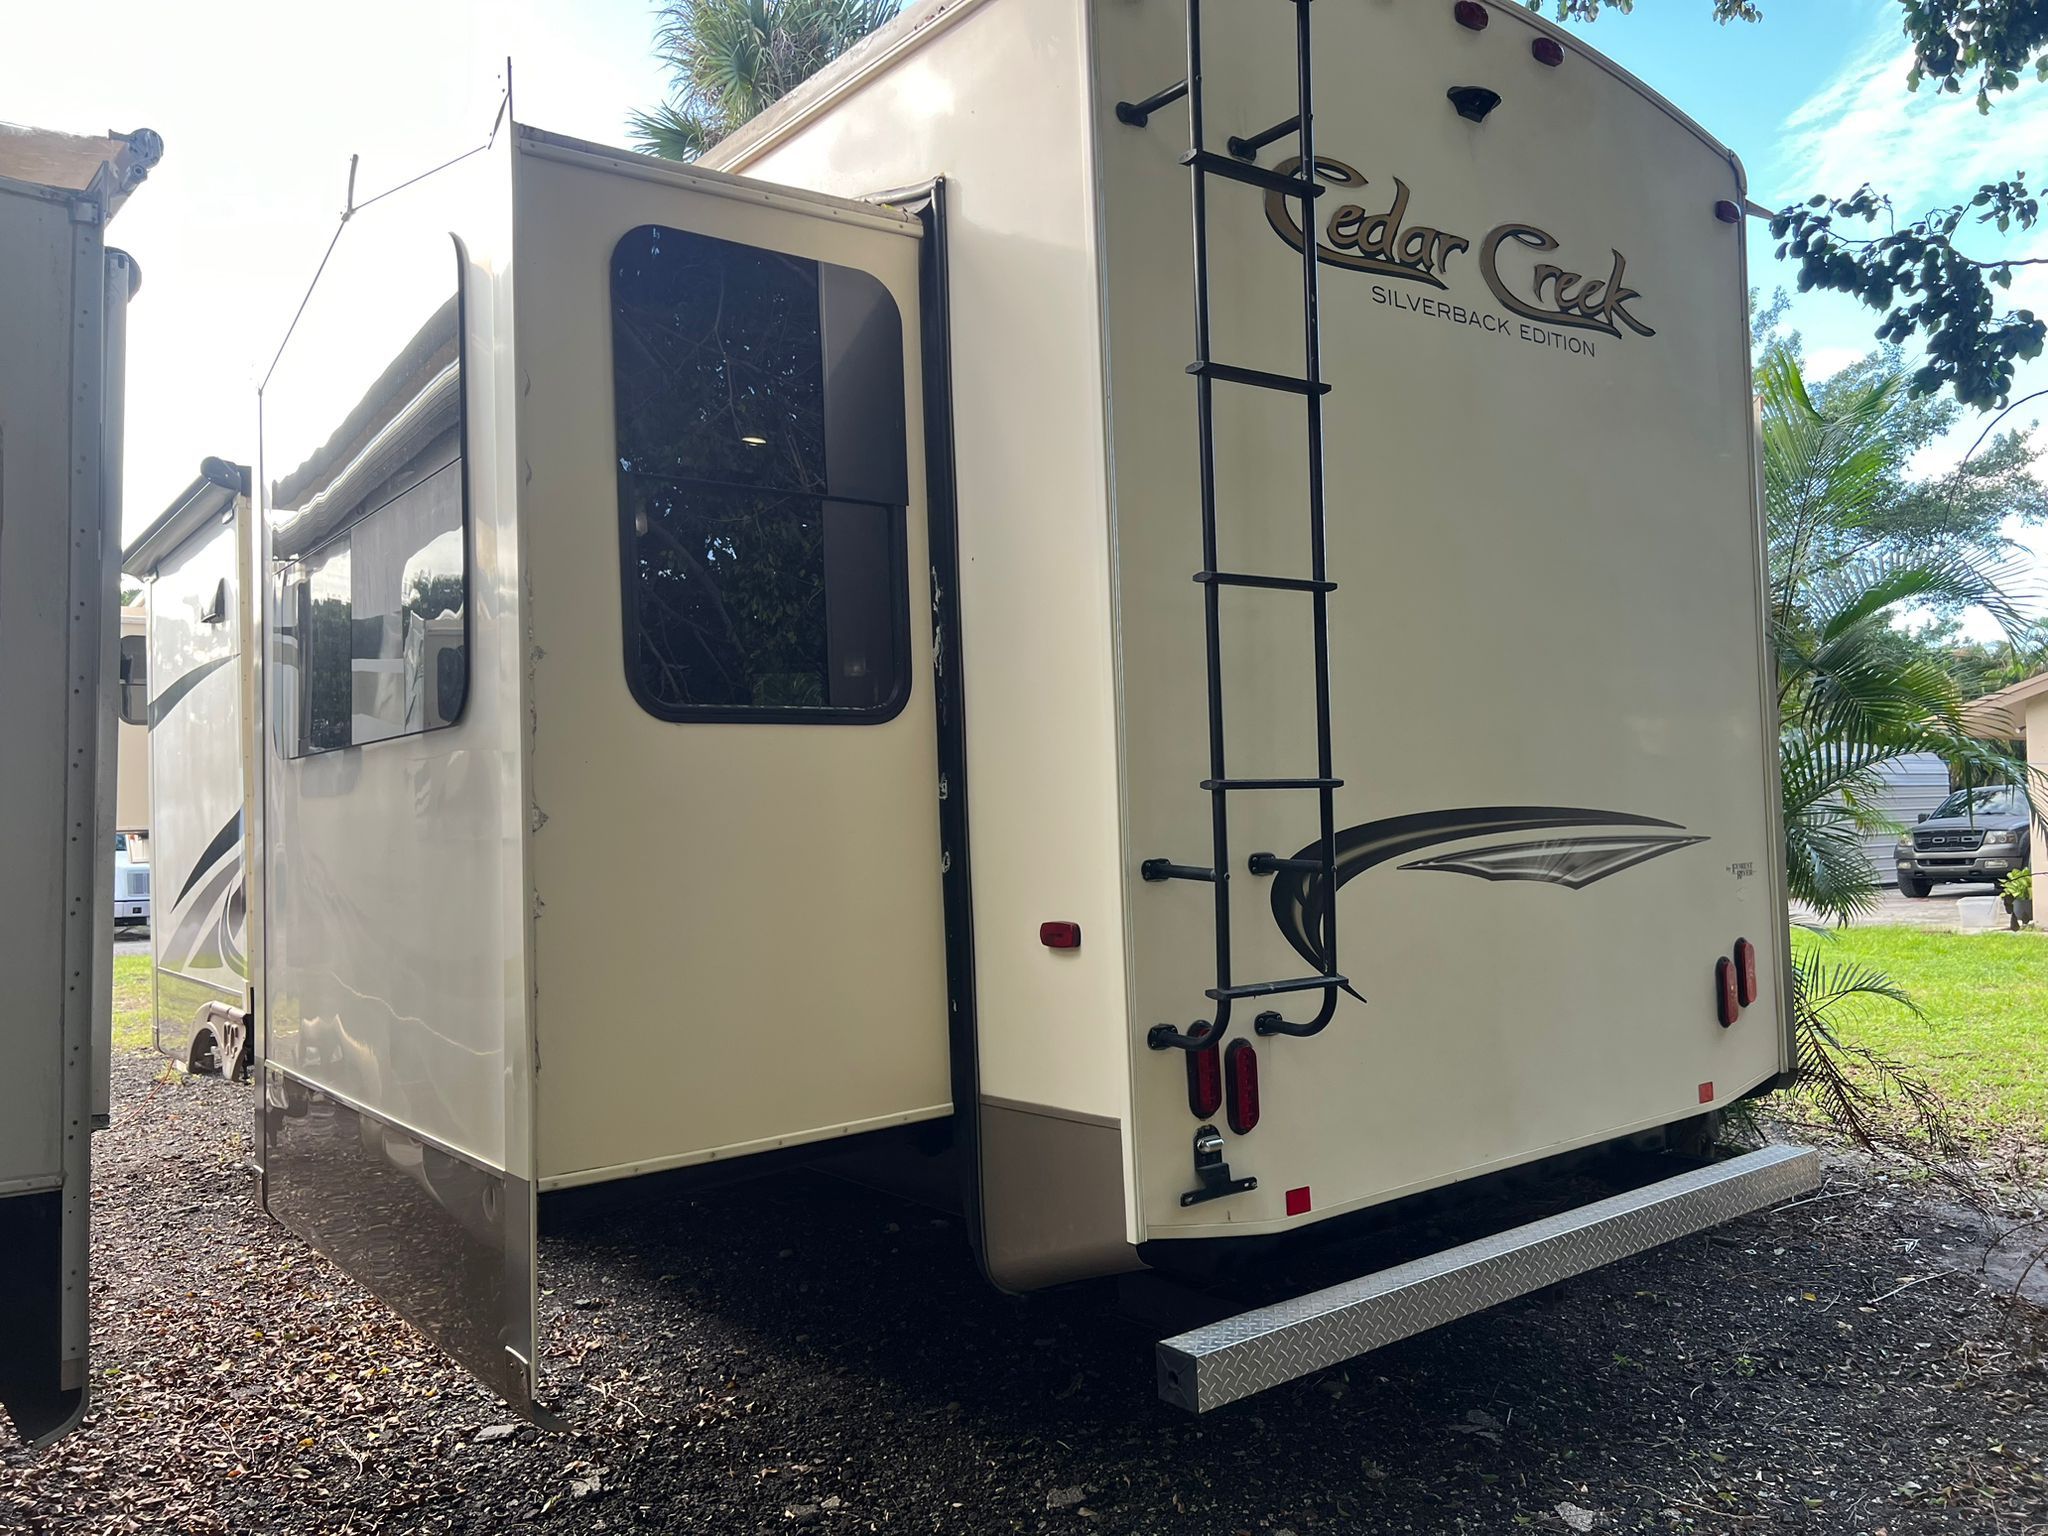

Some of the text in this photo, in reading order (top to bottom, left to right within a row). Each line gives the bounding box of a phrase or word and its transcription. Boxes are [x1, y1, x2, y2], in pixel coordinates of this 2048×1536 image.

[1263, 154, 1657, 340] Cedar Creek
[1371, 284, 1597, 358] SILVERBACK EDITION
